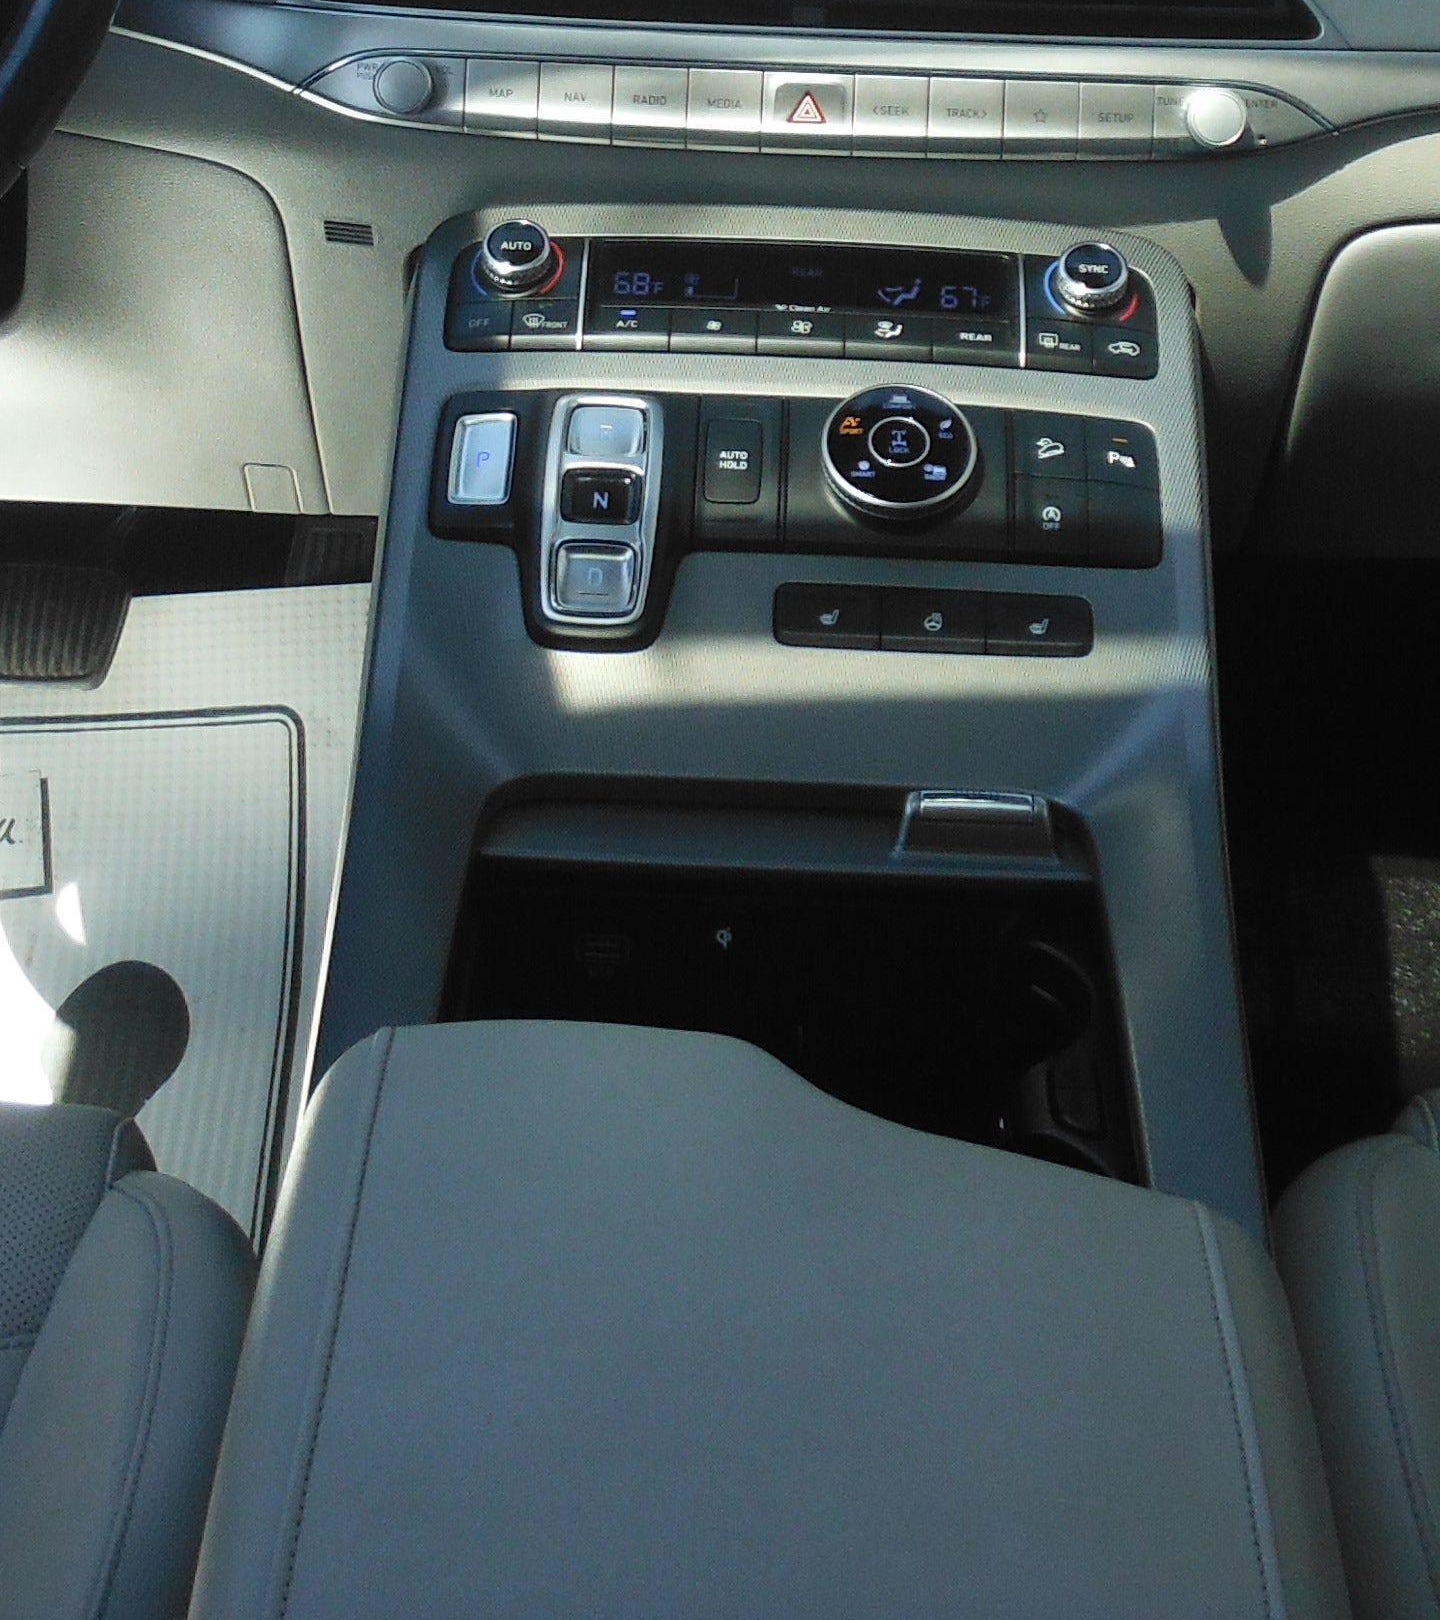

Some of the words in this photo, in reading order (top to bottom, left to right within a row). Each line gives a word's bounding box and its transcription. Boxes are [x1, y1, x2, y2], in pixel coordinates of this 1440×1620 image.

[489, 88, 513, 99] MAP
[564, 91, 587, 103] NAV
[633, 95, 667, 106] RADIO
[707, 98, 742, 110] MEDIA
[1097, 111, 1135, 123] SETUP
[500, 240, 532, 252] AUTO
[1078, 263, 1109, 275] SYNC
[468, 317, 490, 328] OFF
[542, 319, 568, 329] FRONT
[616, 319, 638, 329] A/C
[960, 332, 992, 343] REAR
[1059, 342, 1081, 352] REAR
[476, 451, 490, 467] P
[719, 450, 748, 460] AUTO
[719, 460, 748, 470] HOLD
[593, 491, 609, 510] N
